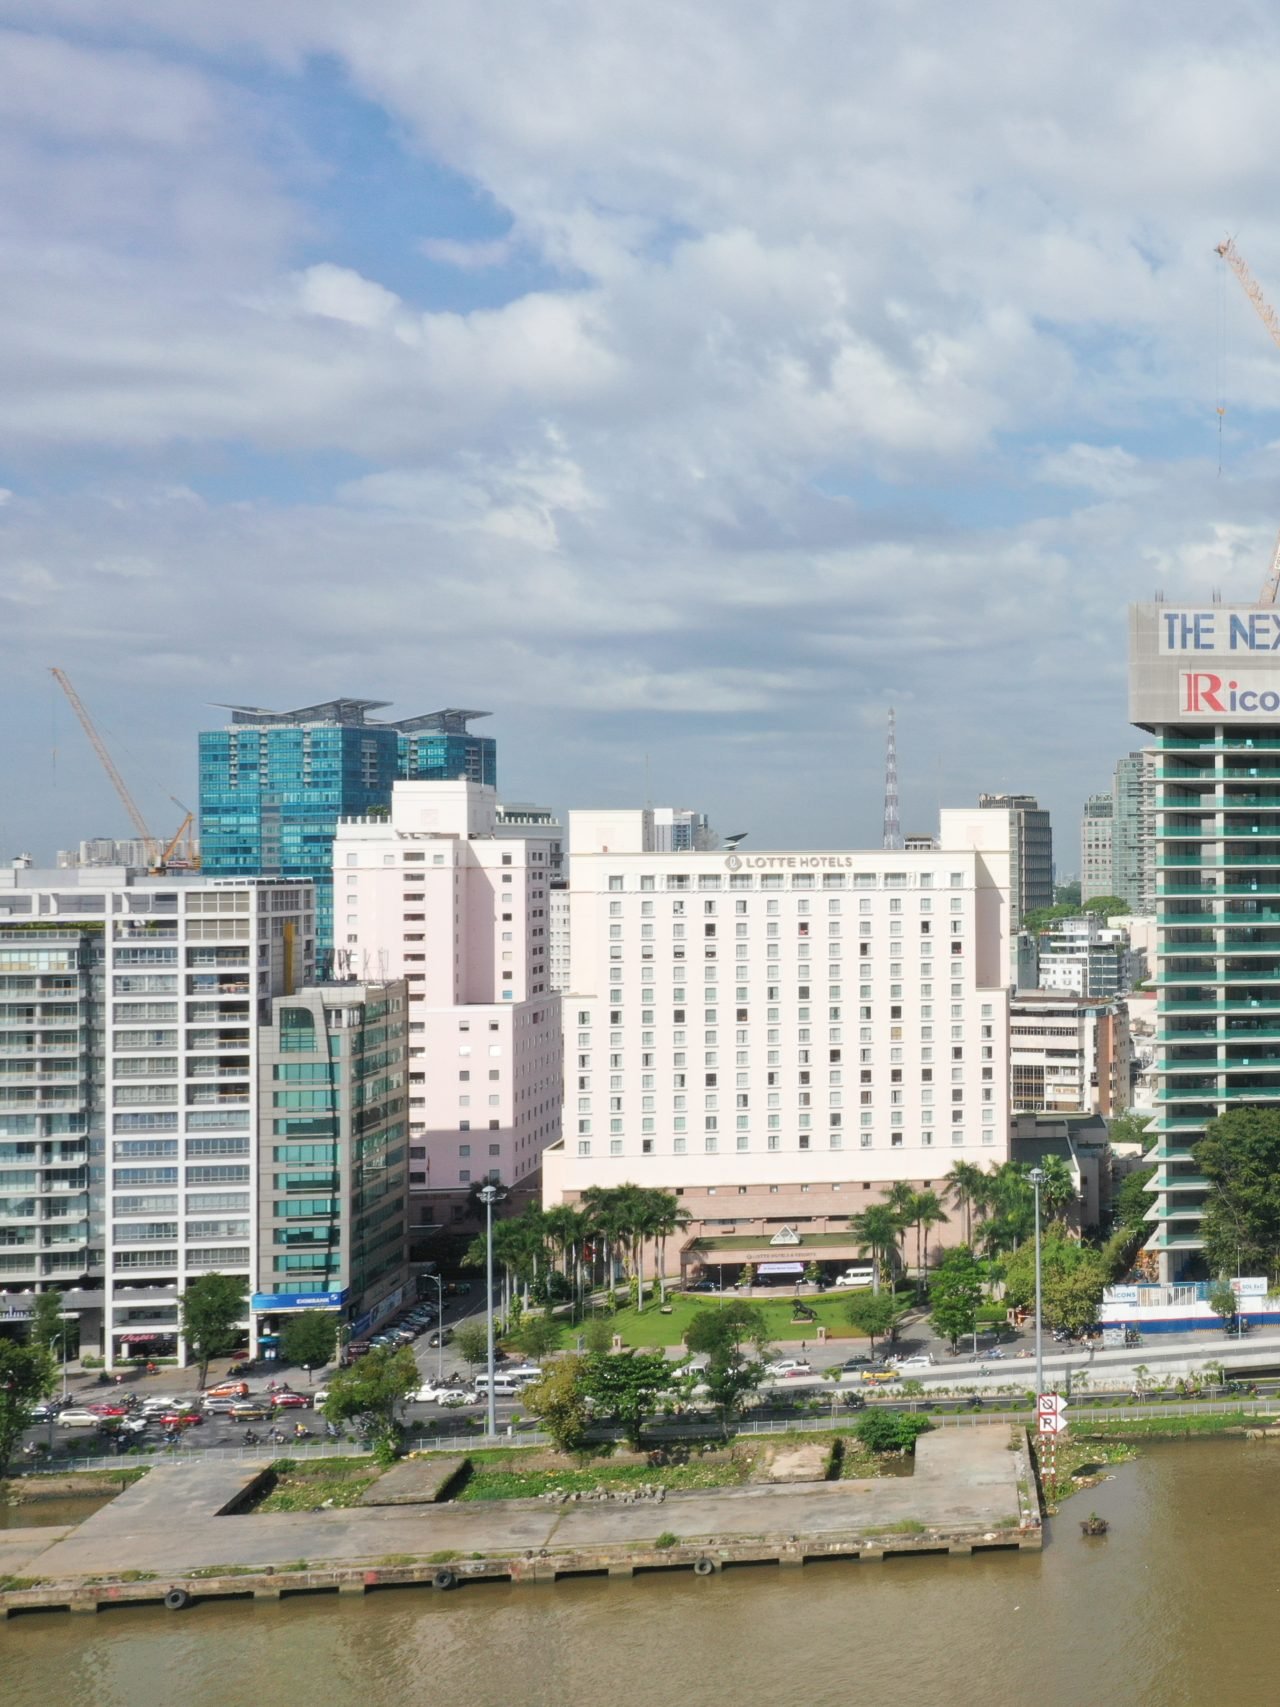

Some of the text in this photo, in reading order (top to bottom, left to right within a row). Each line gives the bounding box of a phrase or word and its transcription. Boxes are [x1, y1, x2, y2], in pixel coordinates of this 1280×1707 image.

[1163, 613, 1215, 650] THE
[746, 857, 853, 868] LOTTE HOTELS
